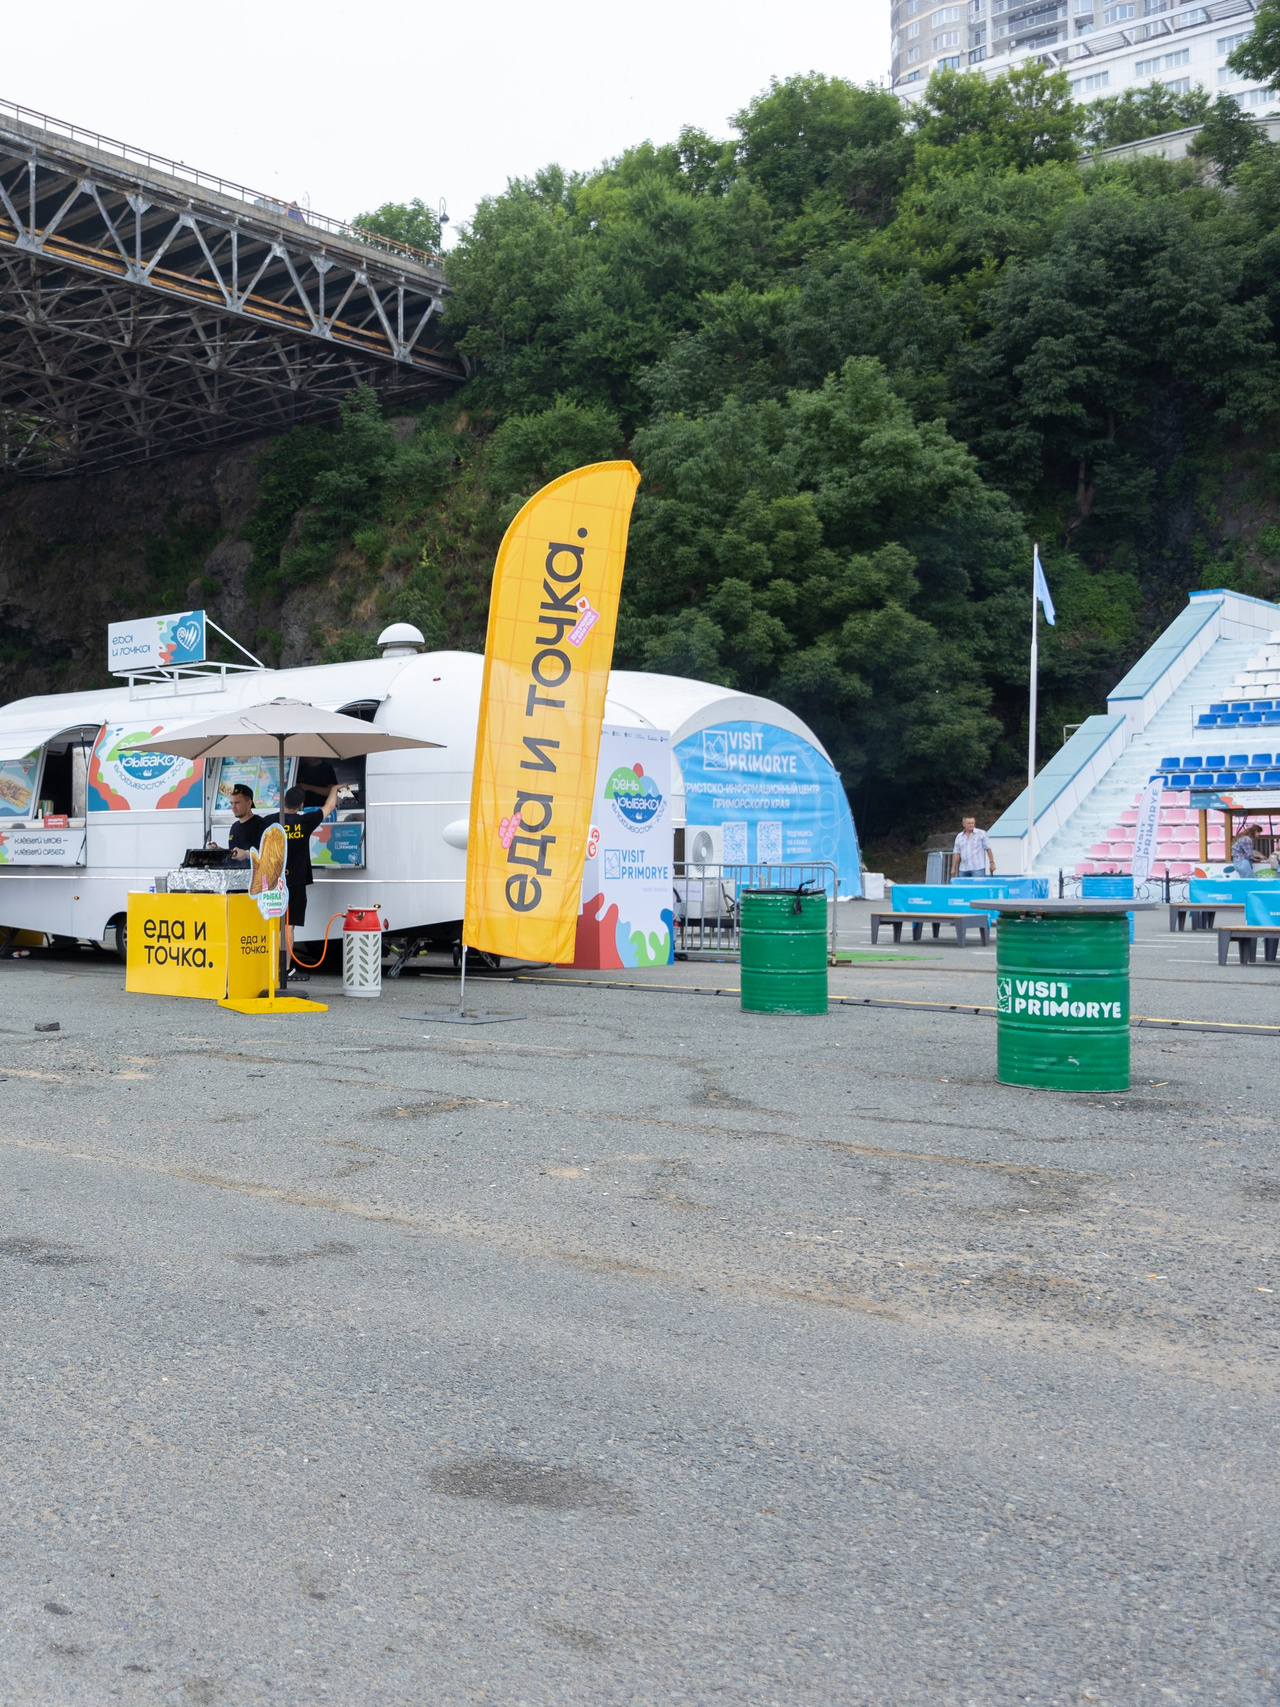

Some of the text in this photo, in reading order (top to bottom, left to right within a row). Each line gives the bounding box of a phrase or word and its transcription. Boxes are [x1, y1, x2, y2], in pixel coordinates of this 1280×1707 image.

[728, 732, 764, 750] VISIT
[520, 736, 560, 773] и
[728, 754, 797, 774] PRIMORYE
[684, 782, 820, 796] РИСТСКО-ИНФОРМАЦИОННЫЙ ЦЕНТР
[712, 798, 790, 809] ПРИМОРСКОГО КРАЯ
[1144, 788, 1158, 856] PRIMORYE
[505, 791, 557, 912] еда
[621, 850, 645, 863] VISIT
[622, 866, 668, 879] PRIMORYE
[143, 919, 207, 943] еда и
[240, 936, 258, 946] еда
[241, 945, 269, 955] точка.
[144, 945, 214, 968] точка.
[1016, 980, 1071, 999] VISIT
[1015, 998, 1122, 1018] PRIMORYE
